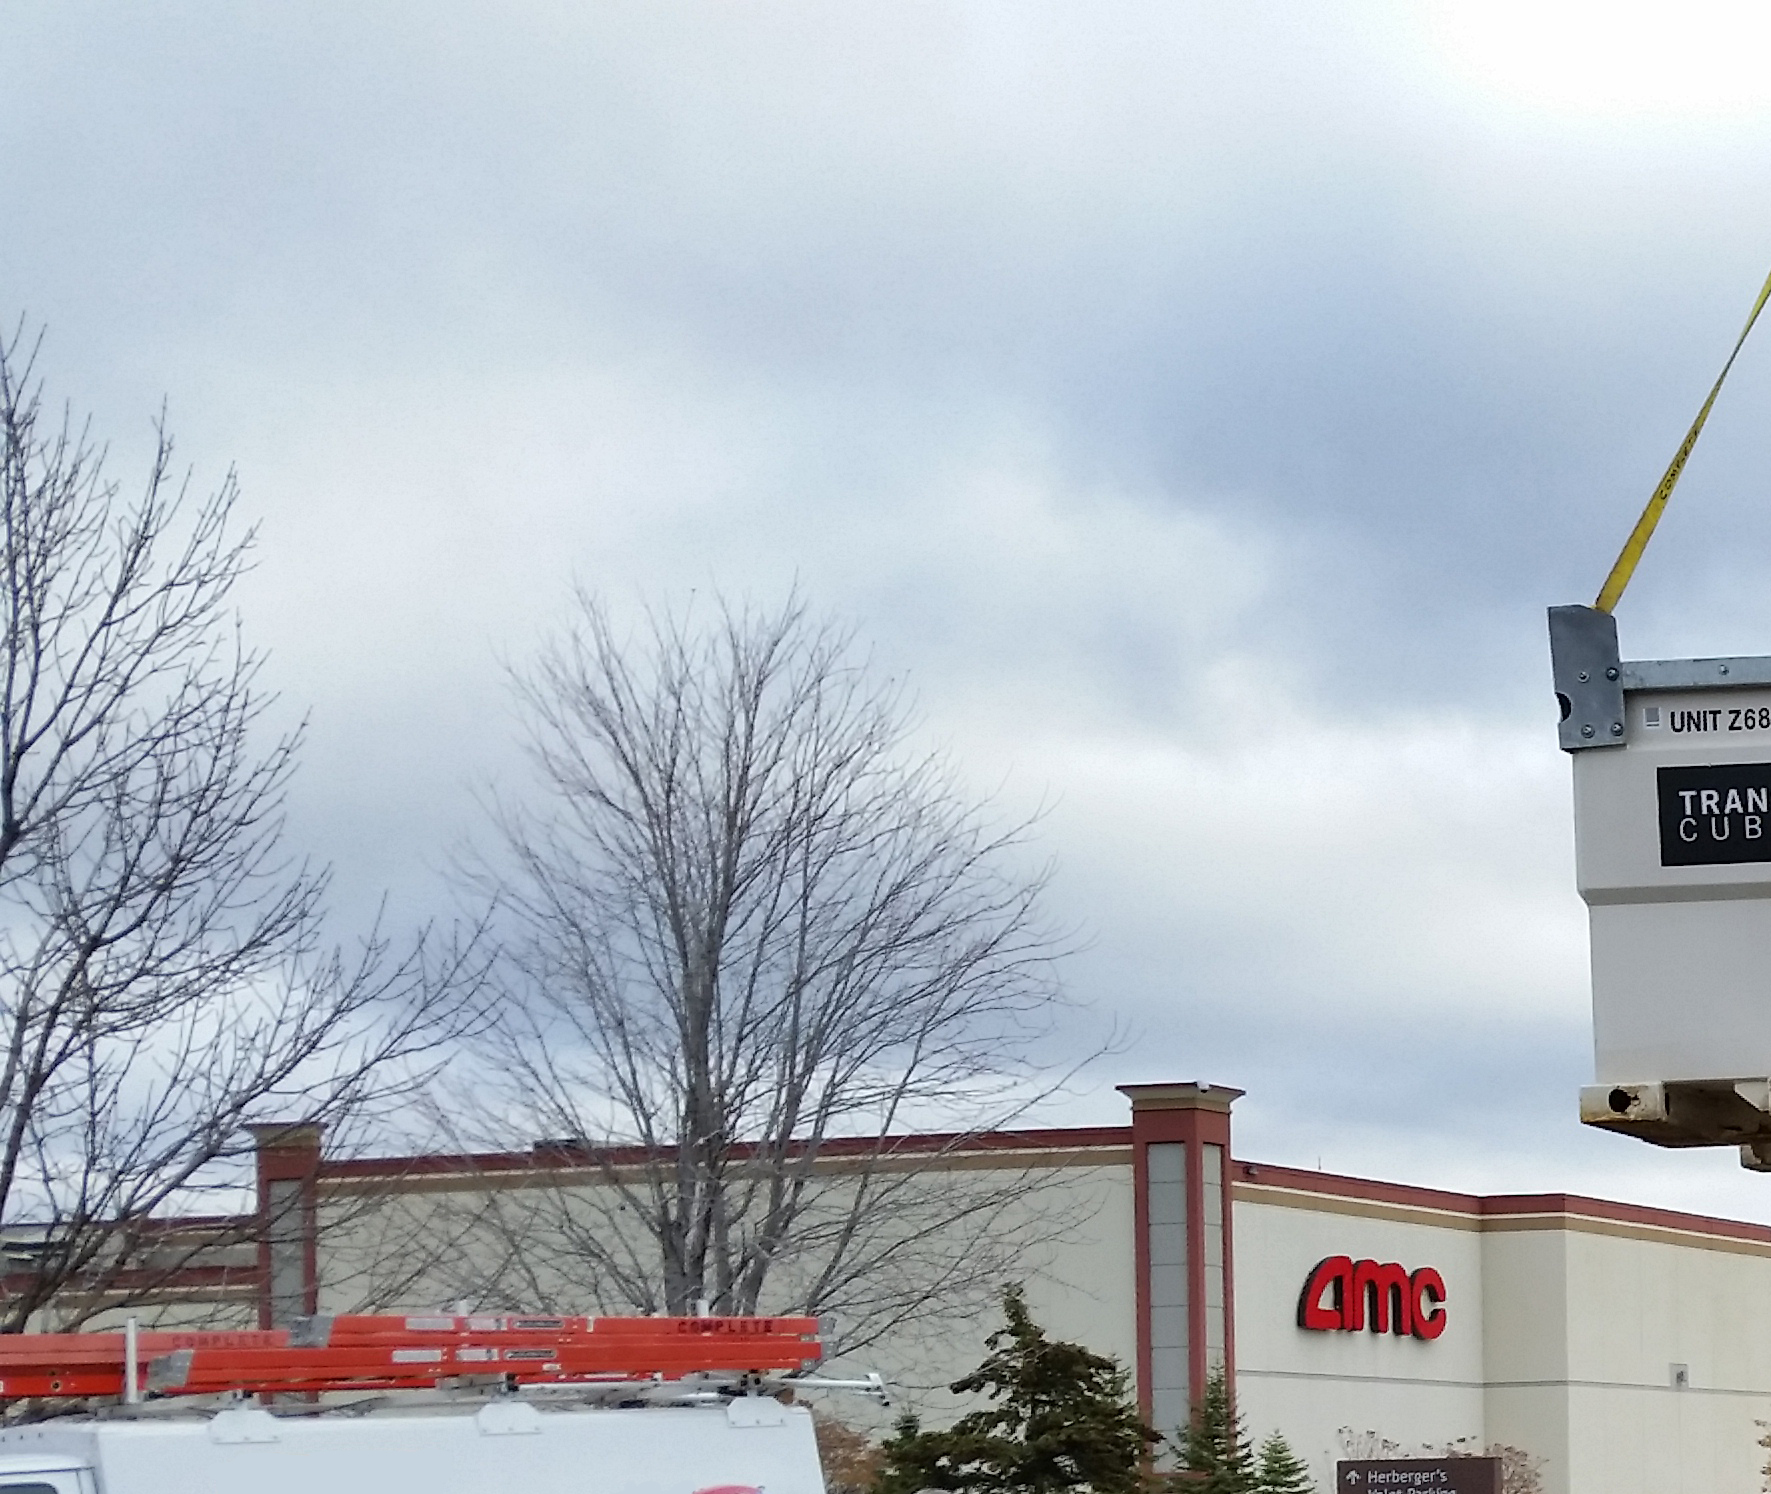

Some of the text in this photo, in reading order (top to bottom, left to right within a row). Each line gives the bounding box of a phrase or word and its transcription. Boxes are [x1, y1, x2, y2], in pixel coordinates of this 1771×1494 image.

[1669, 709, 1722, 733] UNIT
[678, 1320, 774, 1333] COMPLETE
[172, 1334, 272, 1348] COMPLETE
[1367, 1469, 1449, 1486] Herberger's
